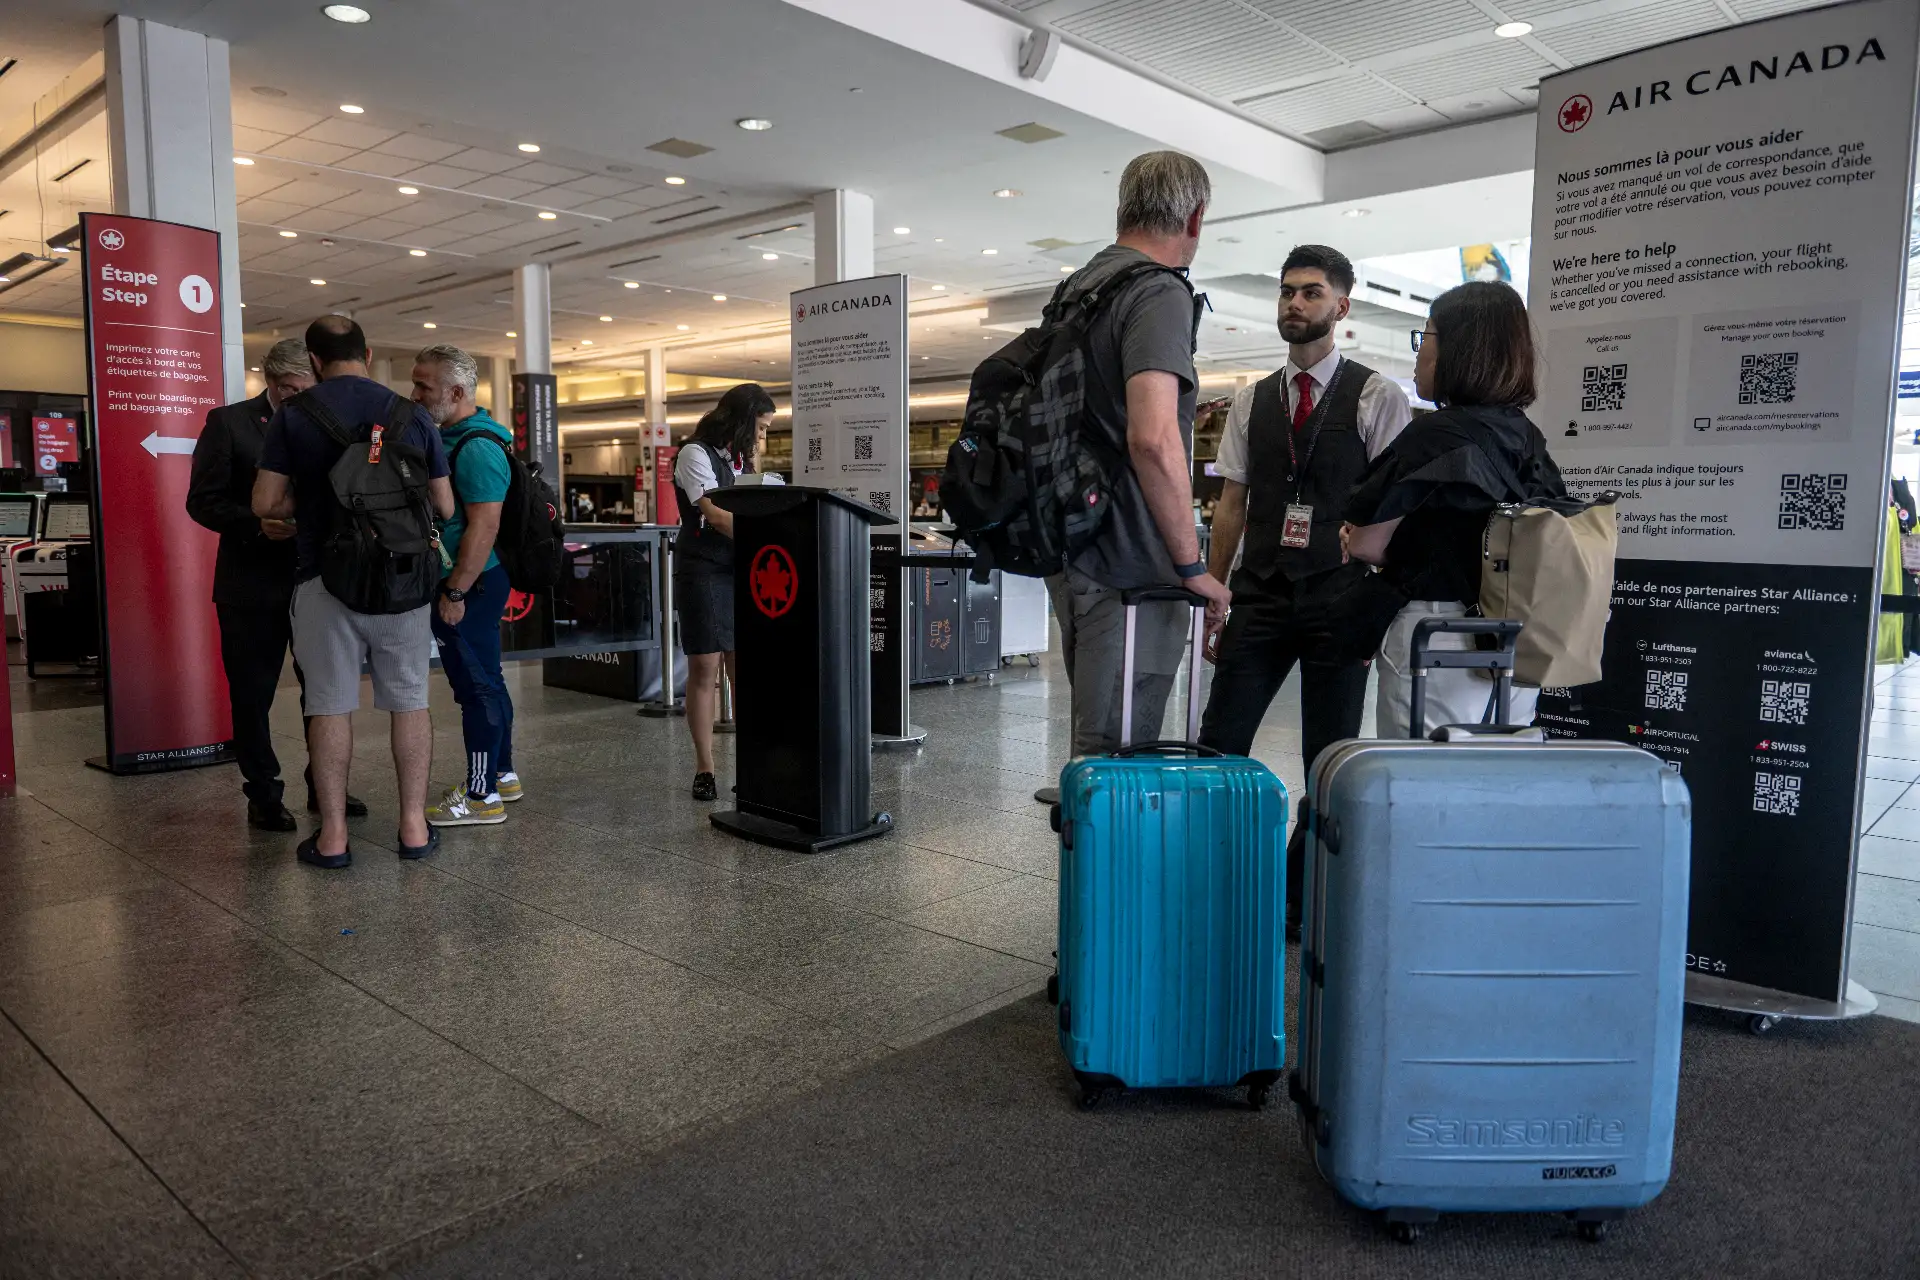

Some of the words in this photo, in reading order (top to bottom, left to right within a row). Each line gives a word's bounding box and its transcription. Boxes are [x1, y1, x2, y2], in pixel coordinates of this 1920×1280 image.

[1607, 80, 1673, 115] AIR
[1685, 37, 1886, 96] CANADA
[1557, 169, 1590, 185] Nous
[1594, 156, 1651, 177] sommes
[1656, 150, 1669, 164] là
[1674, 144, 1711, 165] pour
[1716, 137, 1753, 154] vous
[1759, 128, 1803, 147] aider
[1556, 190, 1564, 201] Si
[1568, 188, 1589, 199] vous
[1593, 182, 1615, 195] avez
[1618, 173, 1662, 190] manqué
[1666, 170, 1681, 179] un
[1685, 163, 1703, 176] vol
[1707, 160, 1721, 173] de
[1726, 146, 1833, 170] correspondance,
[1838, 140, 1865, 156] que
[1555, 202, 1579, 214] votre
[1583, 197, 1598, 209] vol
[1601, 197, 1607, 205] a
[1610, 190, 1626, 204] été
[1630, 184, 1667, 200] annulé
[1671, 183, 1685, 193] ou
[1690, 177, 1712, 192] que
[1716, 173, 1749, 185] vous
[1750, 168, 1778, 181] avez
[1783, 160, 1826, 176] besoin
[1831, 154, 1872, 169] d'aide
[1554, 216, 1576, 230] pour
[1579, 206, 1622, 222] modifier
[1625, 201, 1653, 214] votre
[1657, 190, 1726, 209] réservation,
[1730, 184, 1760, 198] vous
[1764, 179, 1811, 196] pouvez
[1816, 169, 1876, 186] compter
[1554, 231, 1568, 240] sur
[1571, 225, 1597, 237] nous.
[1552, 272, 1593, 287] Whether
[1596, 267, 1630, 283] you've
[1633, 260, 1671, 275] missed
[1675, 261, 1682, 269] a
[1685, 250, 1757, 268] connection,
[1761, 248, 1792, 262] your
[1797, 242, 1833, 258] flight
[1553, 255, 1587, 271] We're
[1591, 252, 1620, 266] here
[1625, 248, 1640, 260] to
[1644, 242, 1676, 258] help
[101, 263, 158, 286] Étape
[1550, 290, 1558, 299] is
[1560, 281, 1606, 298] cancelled
[1609, 282, 1620, 291] or
[1623, 279, 1643, 293] you
[1647, 272, 1675, 287] need
[1678, 266, 1739, 282] assistance
[1744, 263, 1772, 276] with
[1777, 256, 1848, 273] rebooking,
[102, 287, 148, 307] Step
[192, 285, 201, 303] 1
[1550, 300, 1576, 312] we've
[1578, 298, 1596, 311] got
[1598, 296, 1617, 308] you
[1621, 288, 1666, 303] covered.
[809, 303, 829, 317] AIR
[832, 294, 892, 313] CANADA
[1775, 318, 1797, 327] votre
[1799, 315, 1846, 325] réservation
[1721, 333, 1751, 343] Manage
[1753, 332, 1770, 341] your
[1772, 331, 1790, 339] own
[1792, 329, 1825, 338] booking
[106, 343, 152, 354] Imprimez
[155, 348, 179, 356] votre
[180, 350, 201, 359] carte
[146, 356, 152, 365] à
[154, 358, 175, 367] bord
[188, 362, 202, 370] vos
[107, 367, 158, 378] étiquettes
[160, 370, 171, 378] de
[173, 371, 209, 383] bagages.
[108, 390, 132, 399] Print
[135, 393, 157, 401] your
[159, 393, 197, 404] boarding
[199, 397, 216, 406] pass
[108, 403, 128, 411] and
[130, 403, 172, 414] baggage
[174, 405, 195, 416] tags.
[1560, 466, 1591, 475] lication
[1594, 465, 1614, 475] d'Air
[1617, 465, 1653, 474] Canada
[1656, 464, 1694, 476] indique
[1698, 464, 1744, 476] toujours
[1625, 478, 1639, 487] les
[1642, 477, 1662, 489] plus
[1665, 477, 1671, 487] à
[1674, 478, 1696, 489] jour
[1698, 478, 1716, 486] sur
[1719, 477, 1735, 486] les
[1624, 512, 1657, 524] always
[1659, 512, 1676, 522] has
[1680, 513, 1697, 522] the
[1700, 514, 1728, 522] most
[1622, 525, 1639, 534] and
[1642, 525, 1668, 536] flight
[1672, 526, 1735, 536] information.
[1643, 582, 1657, 593] de
[1660, 585, 1682, 594] nos
[1685, 585, 1757, 599] partenaires
[1760, 587, 1789, 600] Star
[1792, 589, 1849, 602] Alliance
[1627, 597, 1647, 606] our
[1649, 597, 1672, 608] Star
[1675, 598, 1721, 611] Alliance
[1724, 603, 1780, 615] partners:
[1652, 642, 1697, 654] Lufthansa
[1764, 650, 1803, 660] avianca
[1564, 716, 1590, 726] AIRLINES
[137, 751, 165, 761] STAR
[168, 745, 216, 759] ALLIANCE
[1771, 741, 1807, 753] SWISS
[1406, 1113, 1626, 1148] Samsonite
[1544, 1165, 1616, 1179] YUKAKO
